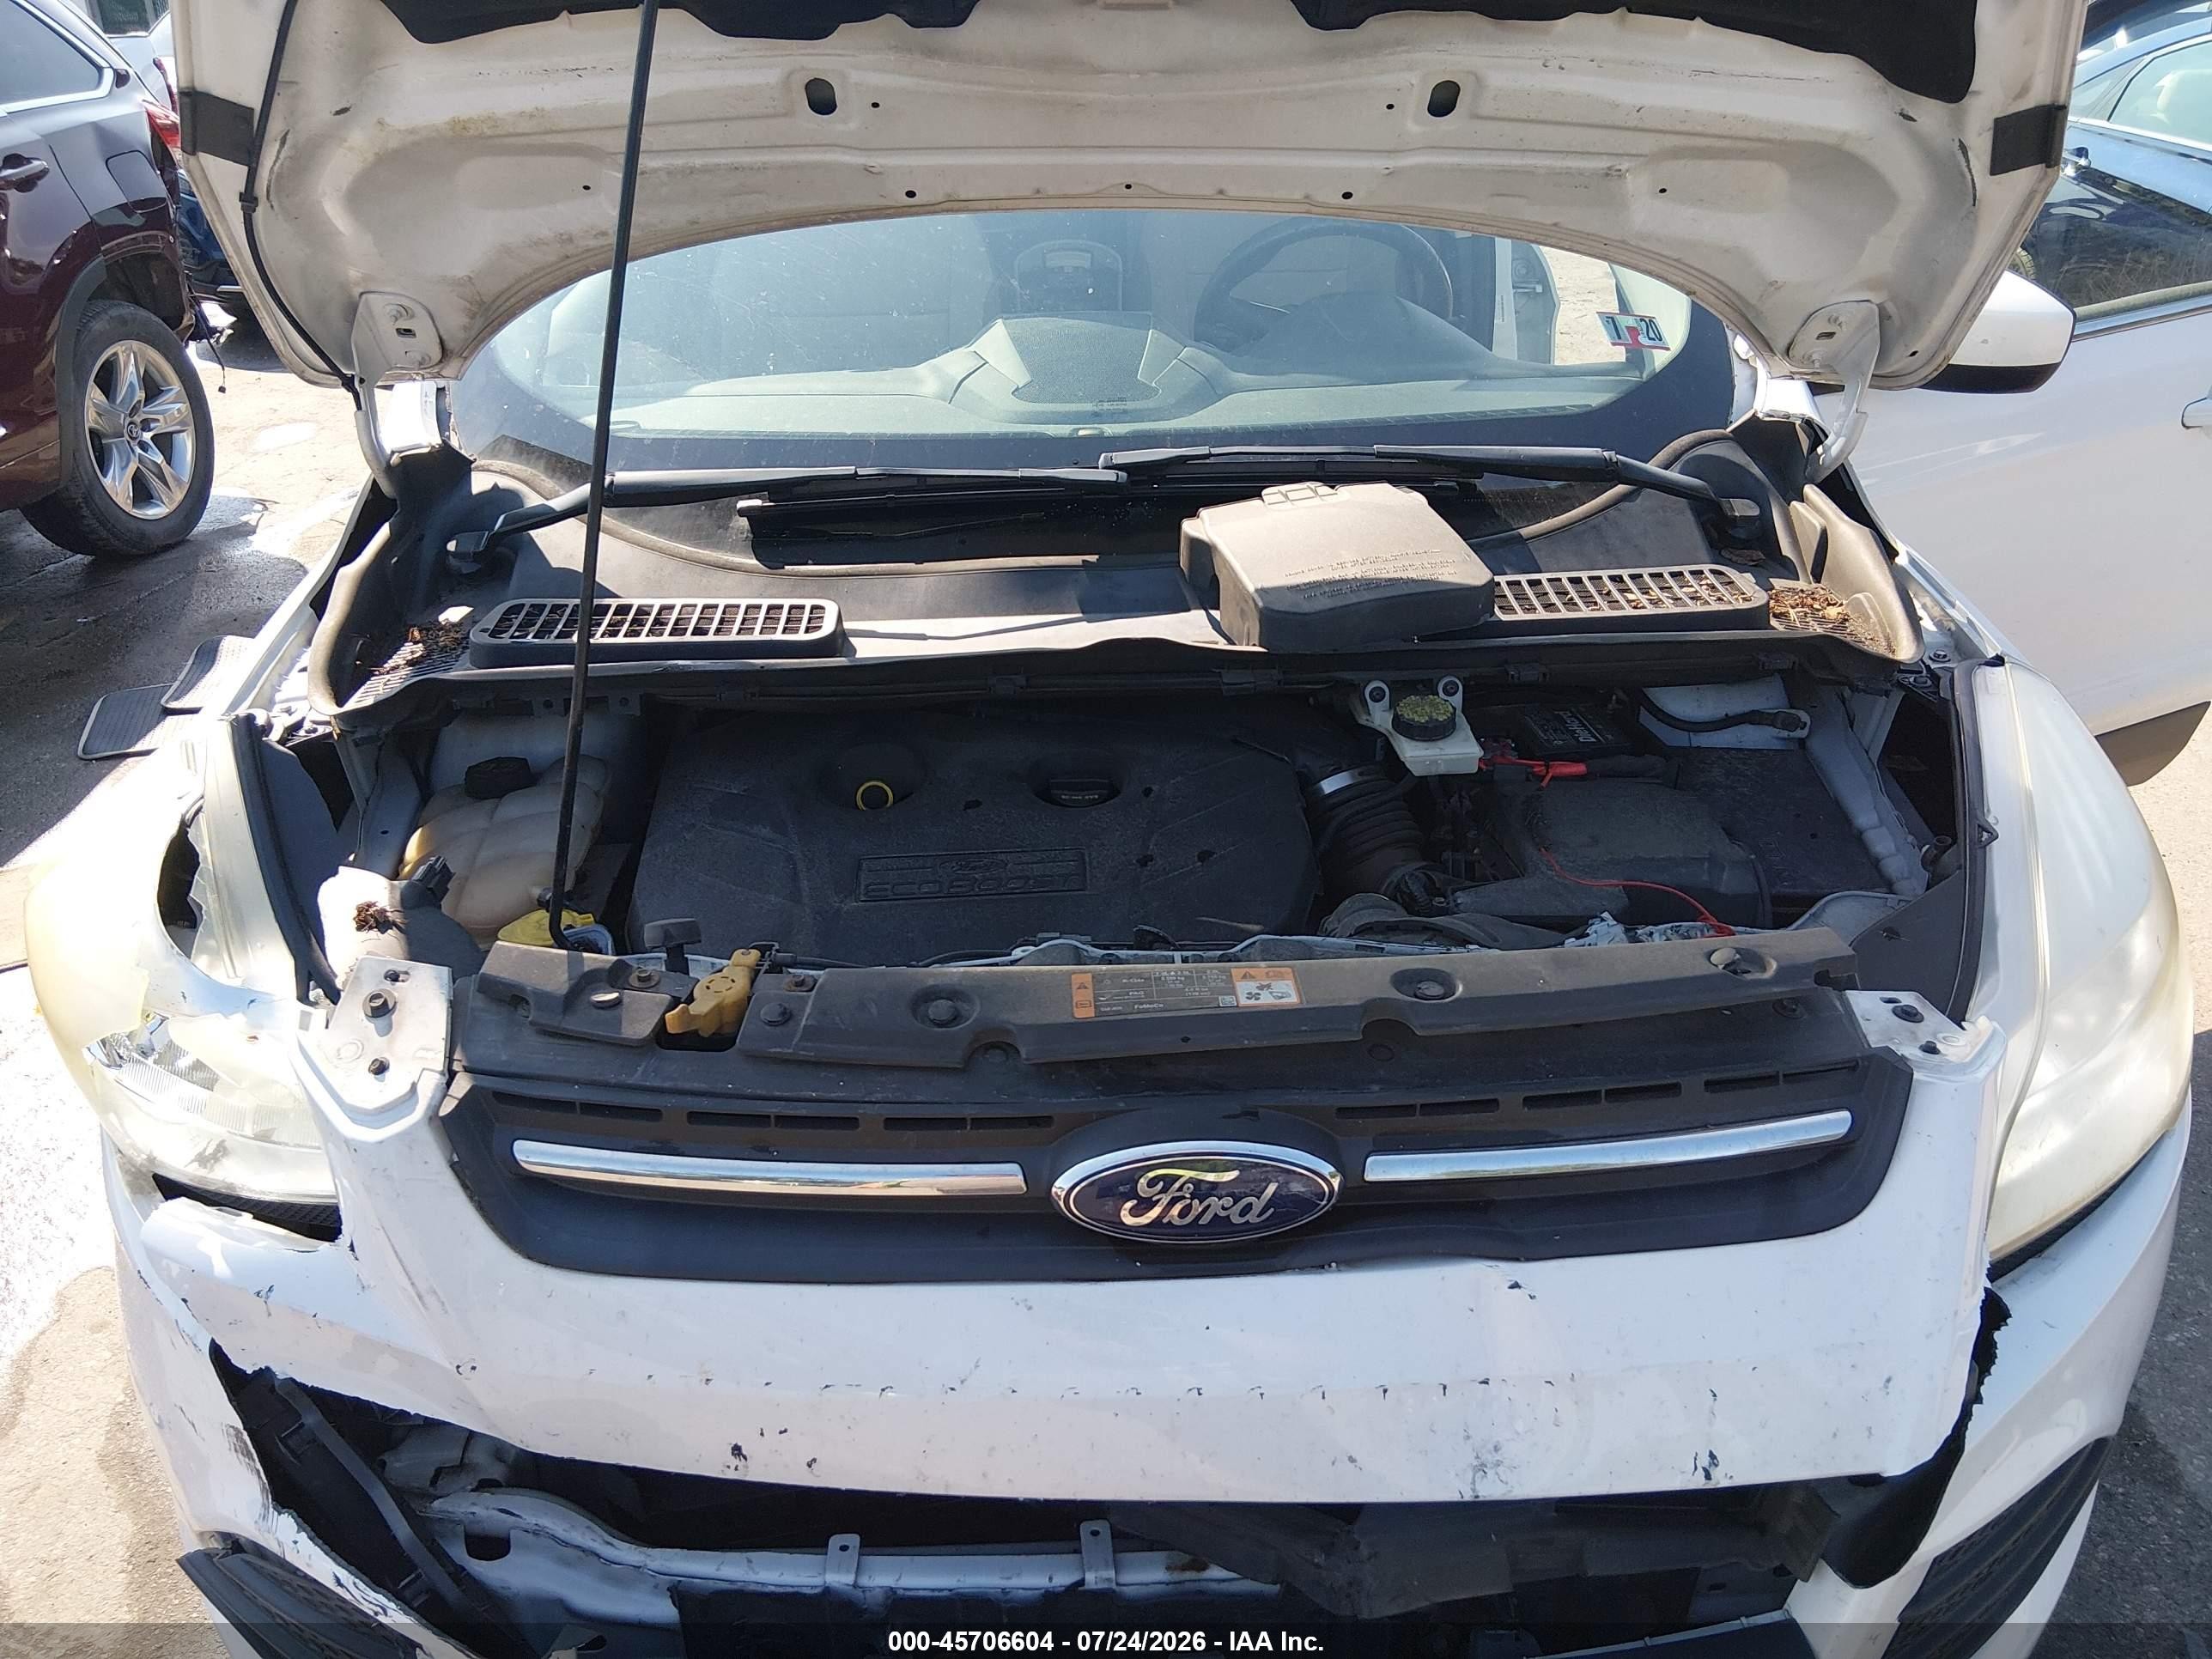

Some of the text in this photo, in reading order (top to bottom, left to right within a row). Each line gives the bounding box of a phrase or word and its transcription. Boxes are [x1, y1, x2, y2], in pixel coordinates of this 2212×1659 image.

[1639, 318, 1663, 342] 20
[1553, 710, 1597, 743] DieHard
[1120, 1168, 1279, 1227] Ford
